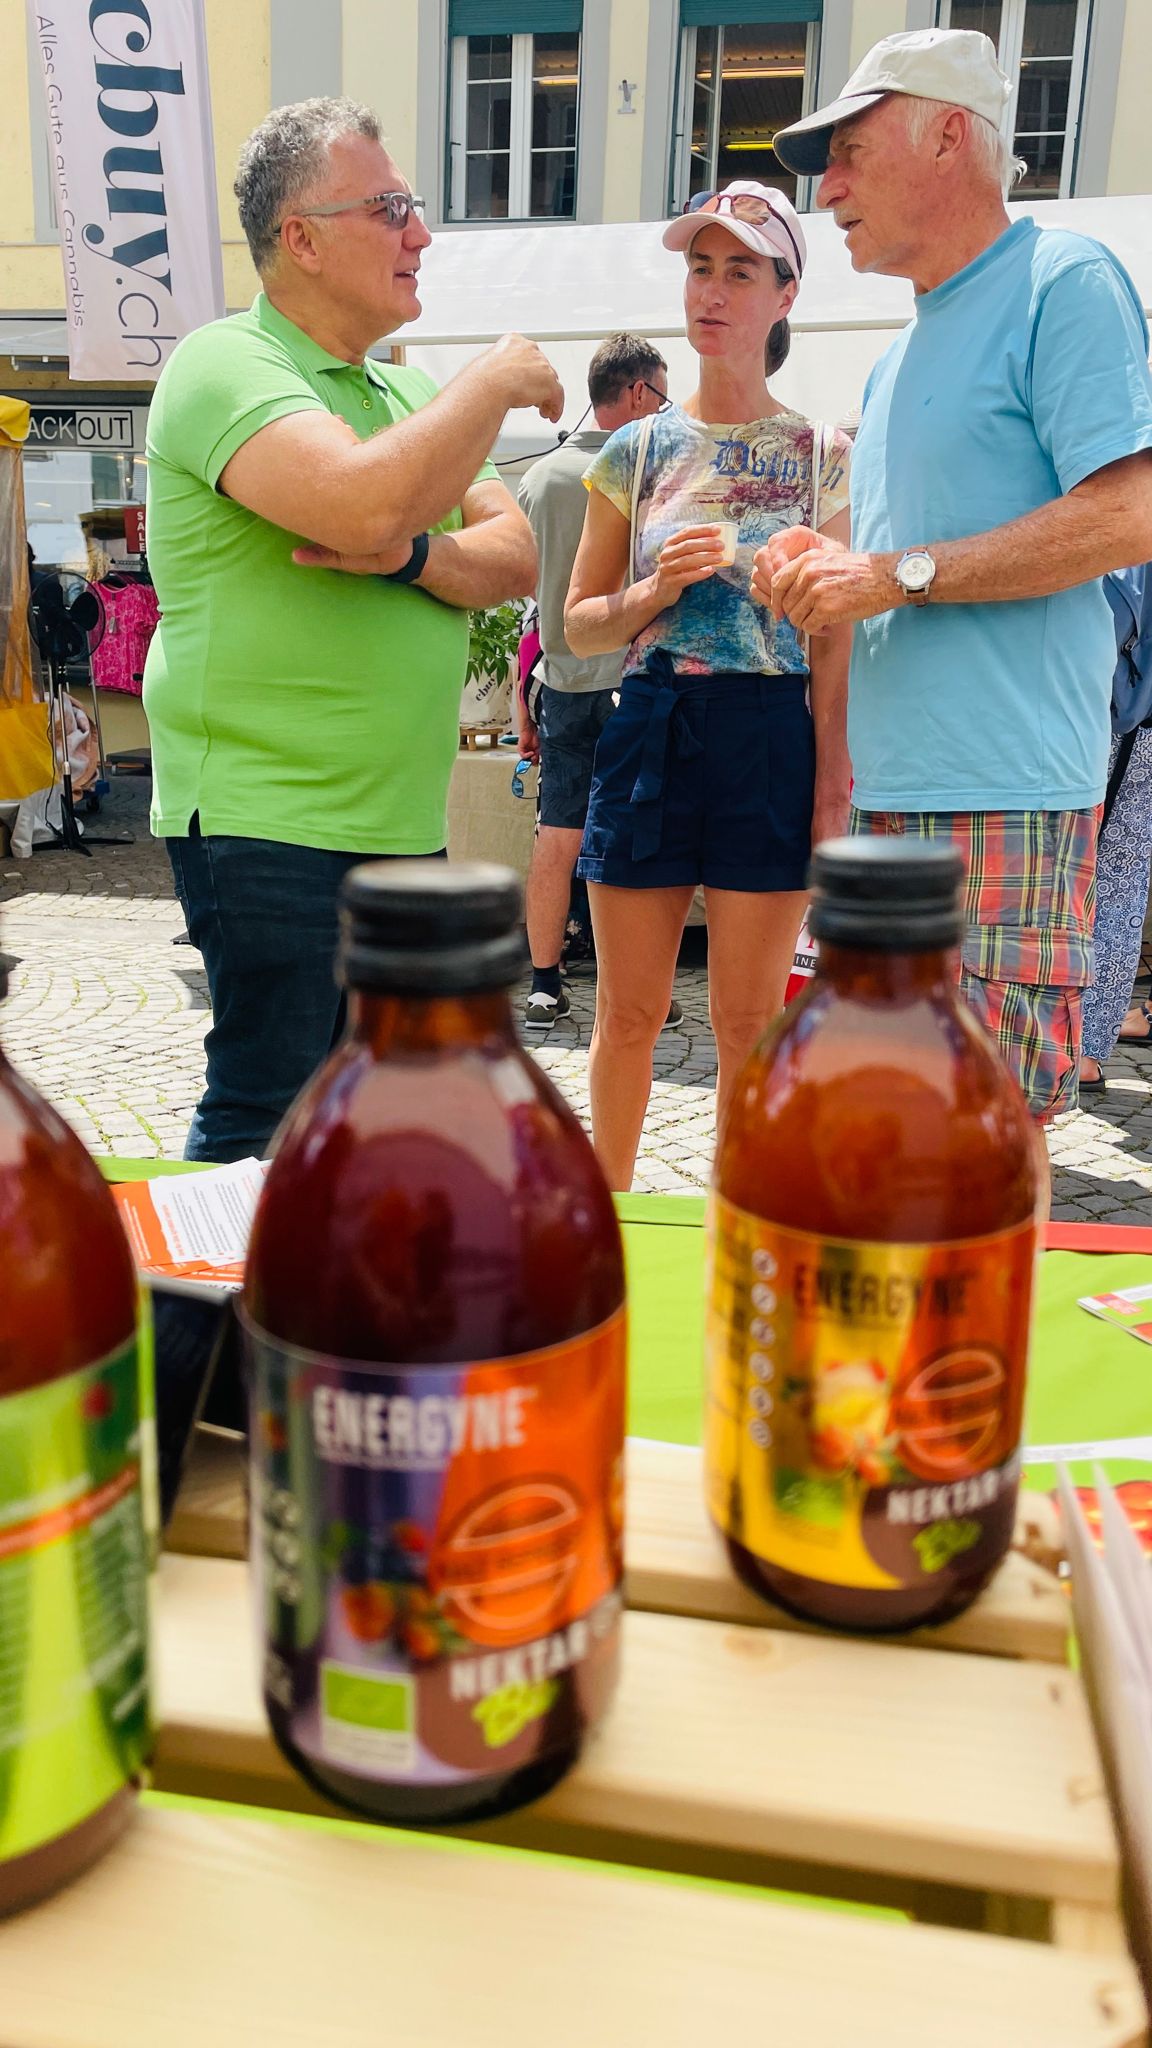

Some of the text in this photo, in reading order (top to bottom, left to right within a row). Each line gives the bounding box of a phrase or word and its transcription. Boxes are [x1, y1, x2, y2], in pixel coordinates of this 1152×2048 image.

[37, 15, 58, 76] Alles
[47, 84, 63, 146] Gute
[136, 511, 146, 552] SALE
[450, 1617, 589, 1703] NEKTAR
